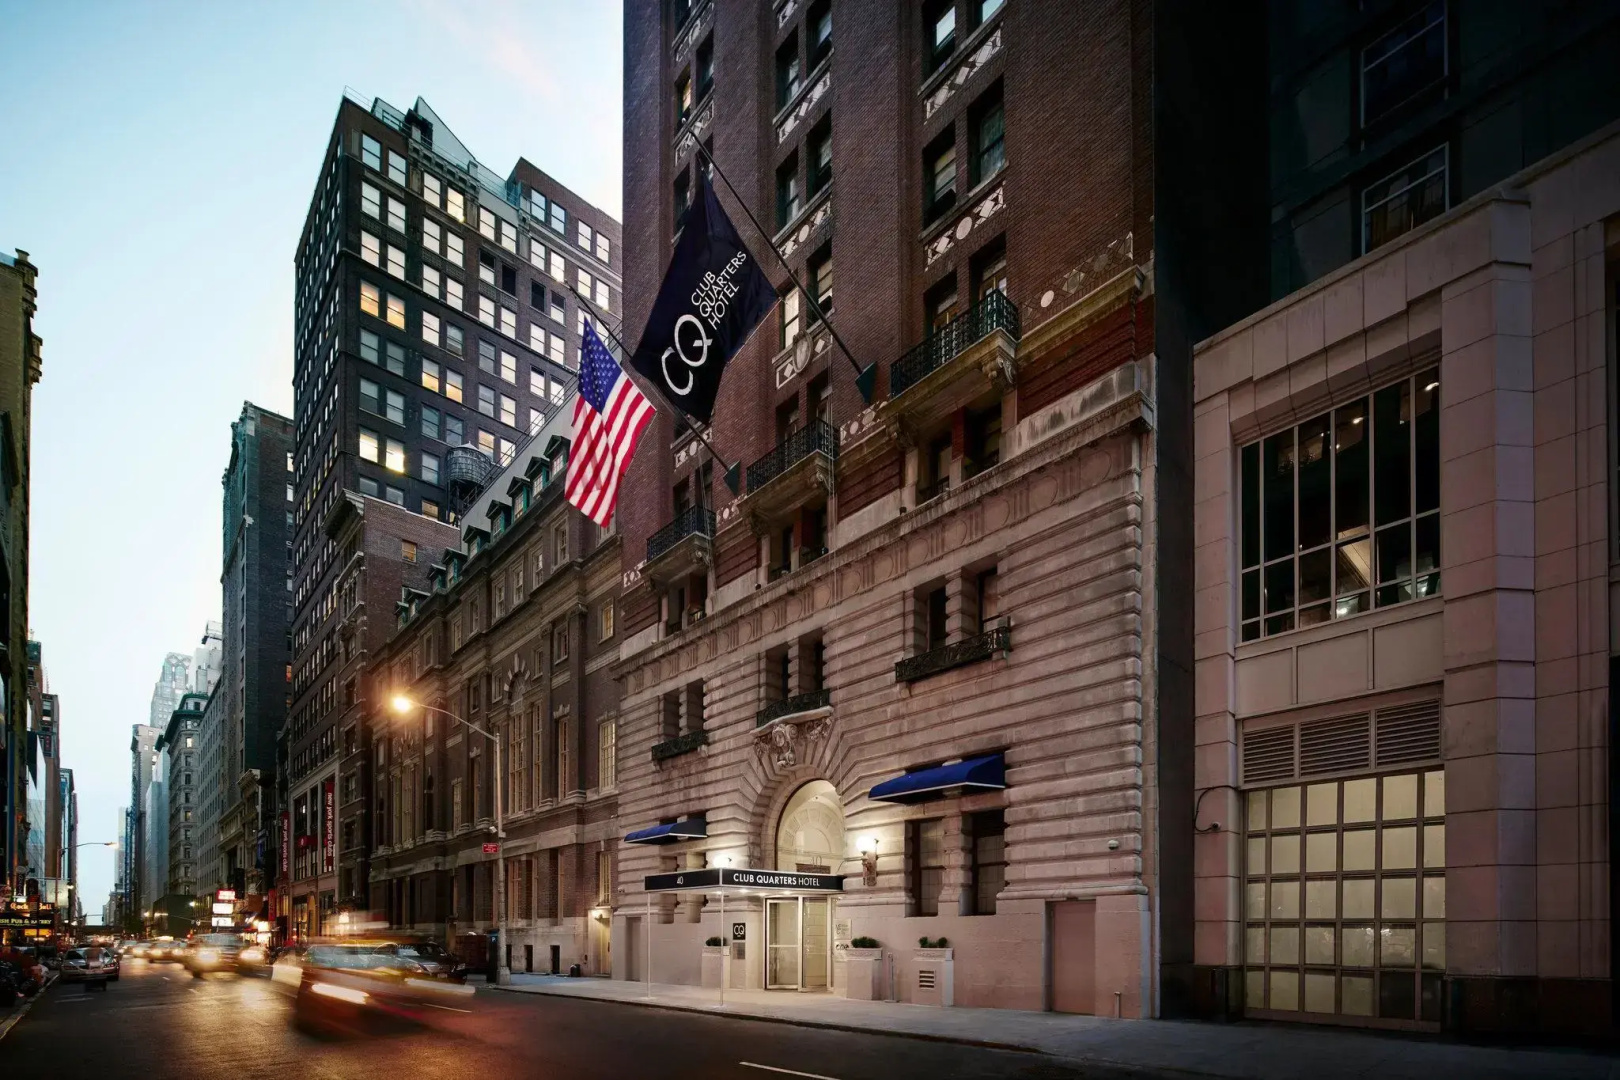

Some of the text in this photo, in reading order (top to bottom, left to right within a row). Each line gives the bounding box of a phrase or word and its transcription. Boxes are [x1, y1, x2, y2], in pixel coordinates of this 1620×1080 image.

[691, 271, 716, 306] CLUB
[700, 251, 747, 317] QUARTERS
[708, 282, 739, 330] HOTEL
[661, 314, 713, 395] CQ
[676, 875, 684, 885] 40
[733, 873, 820, 886] CLUB QUARTERS HOTEL
[733, 924, 745, 935] CQ
